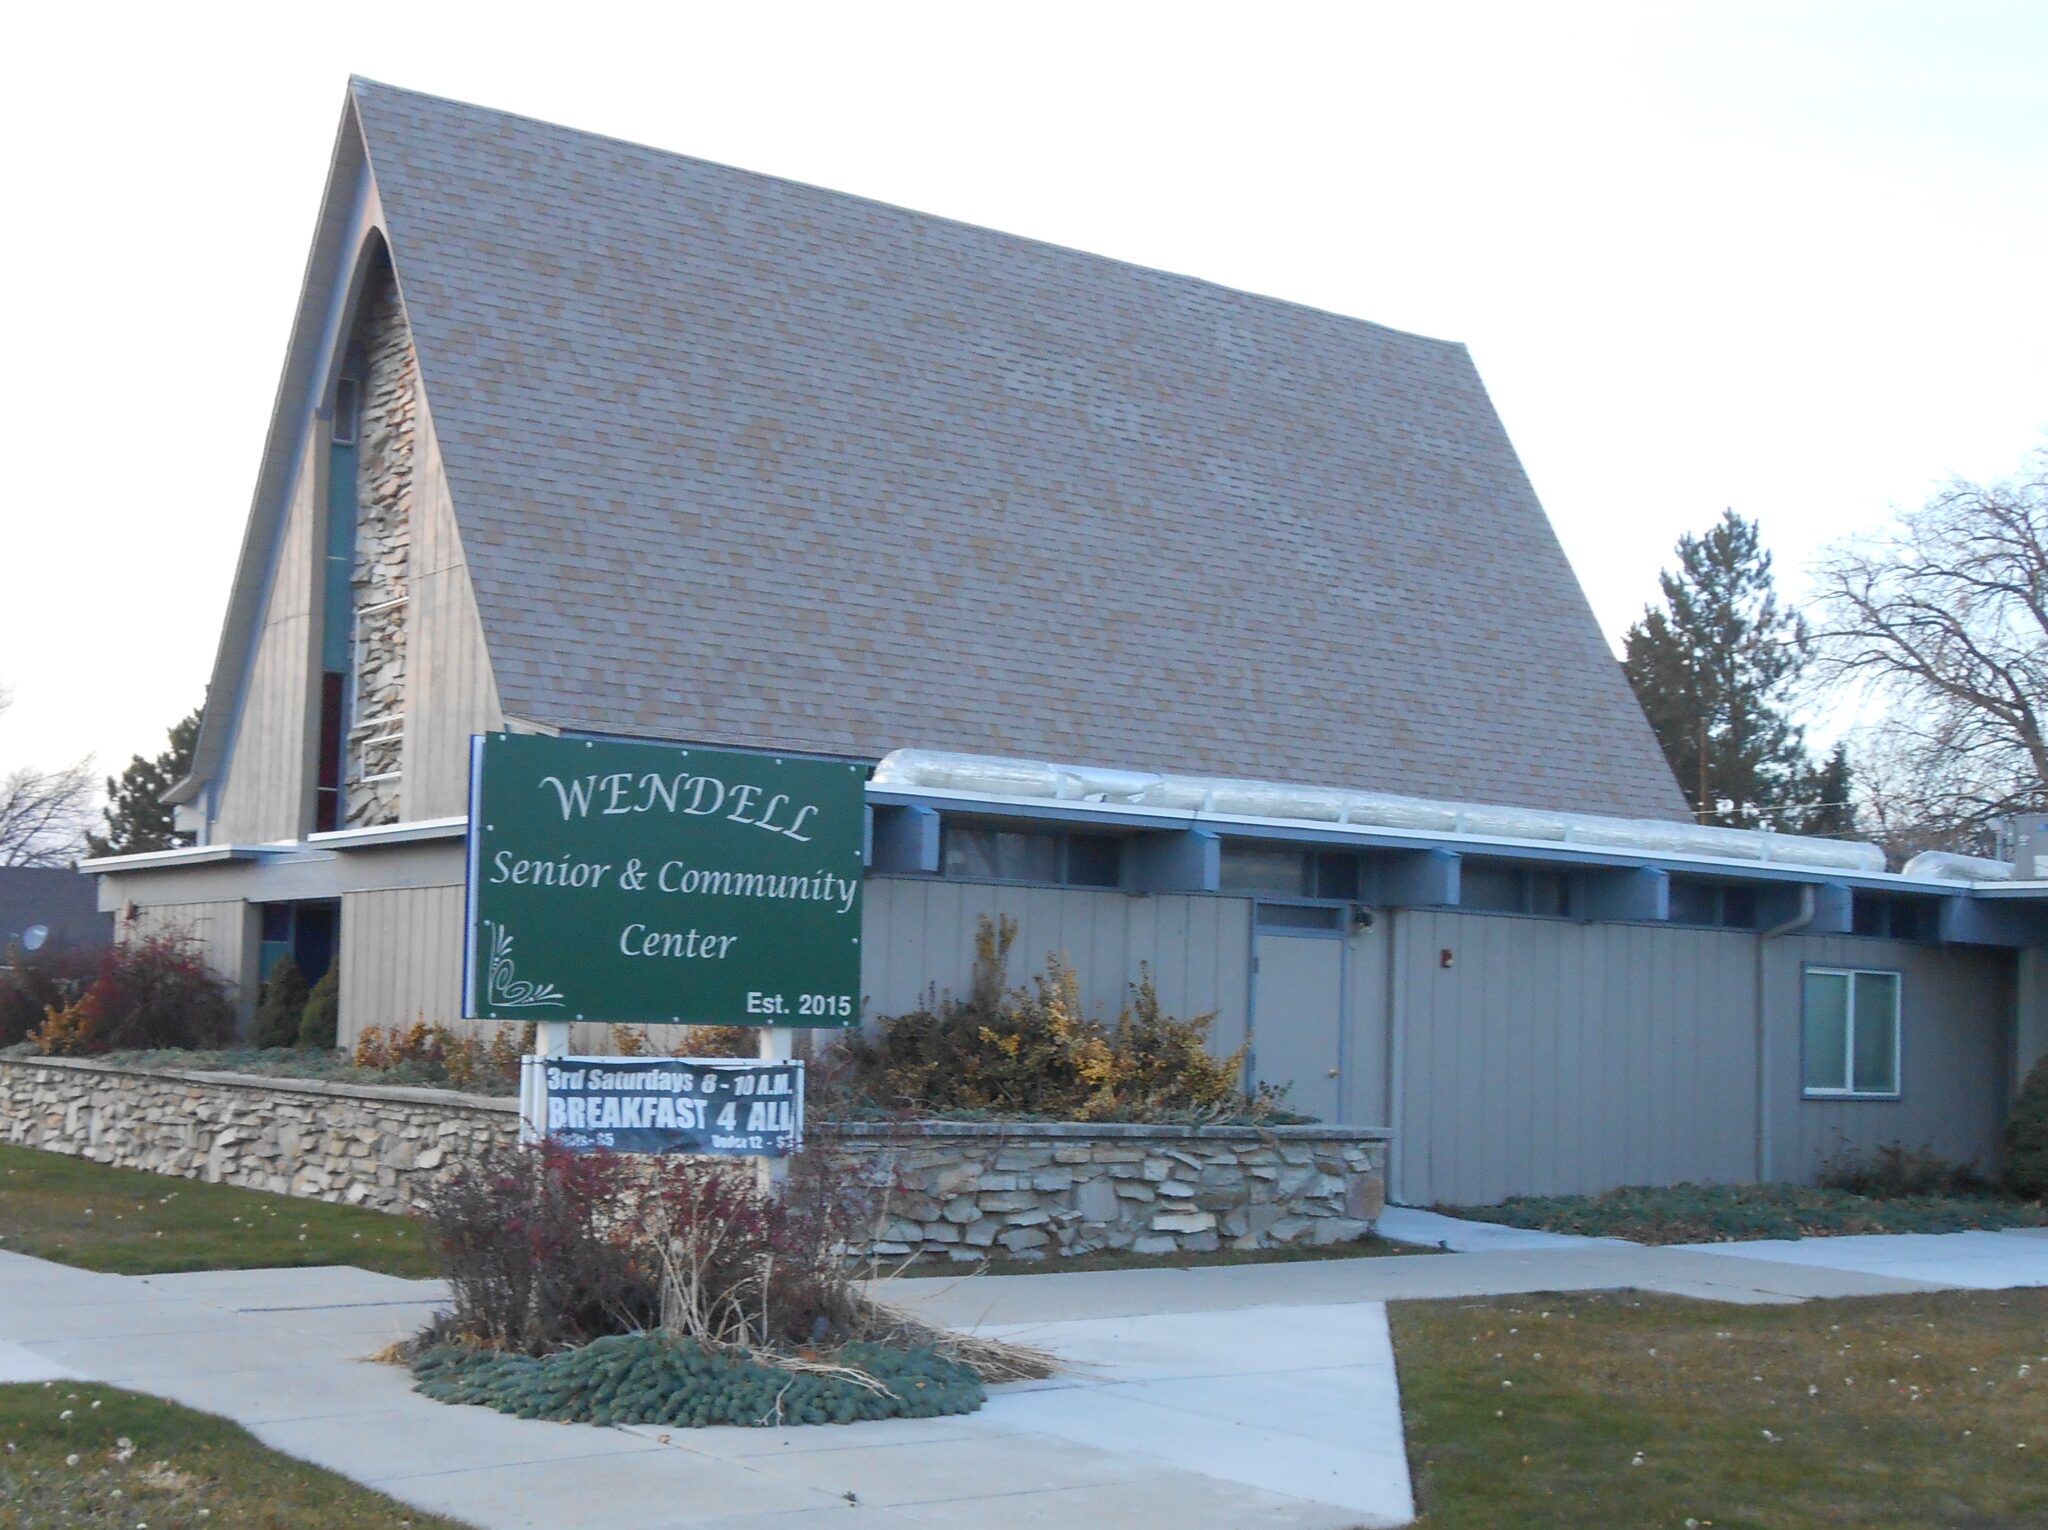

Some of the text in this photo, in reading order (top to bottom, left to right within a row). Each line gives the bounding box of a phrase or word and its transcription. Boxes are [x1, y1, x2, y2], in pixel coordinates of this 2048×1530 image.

[538, 772, 819, 842] WENDELL
[490, 850, 858, 914] Senior & Community
[619, 923, 738, 960] Center
[747, 992, 852, 1016] Est. 2015
[547, 1067, 585, 1090] 3rd
[587, 1069, 694, 1093] Saturdays
[734, 1075, 755, 1096] 10
[548, 1097, 791, 1132] BREAKFAST 4 ALL
